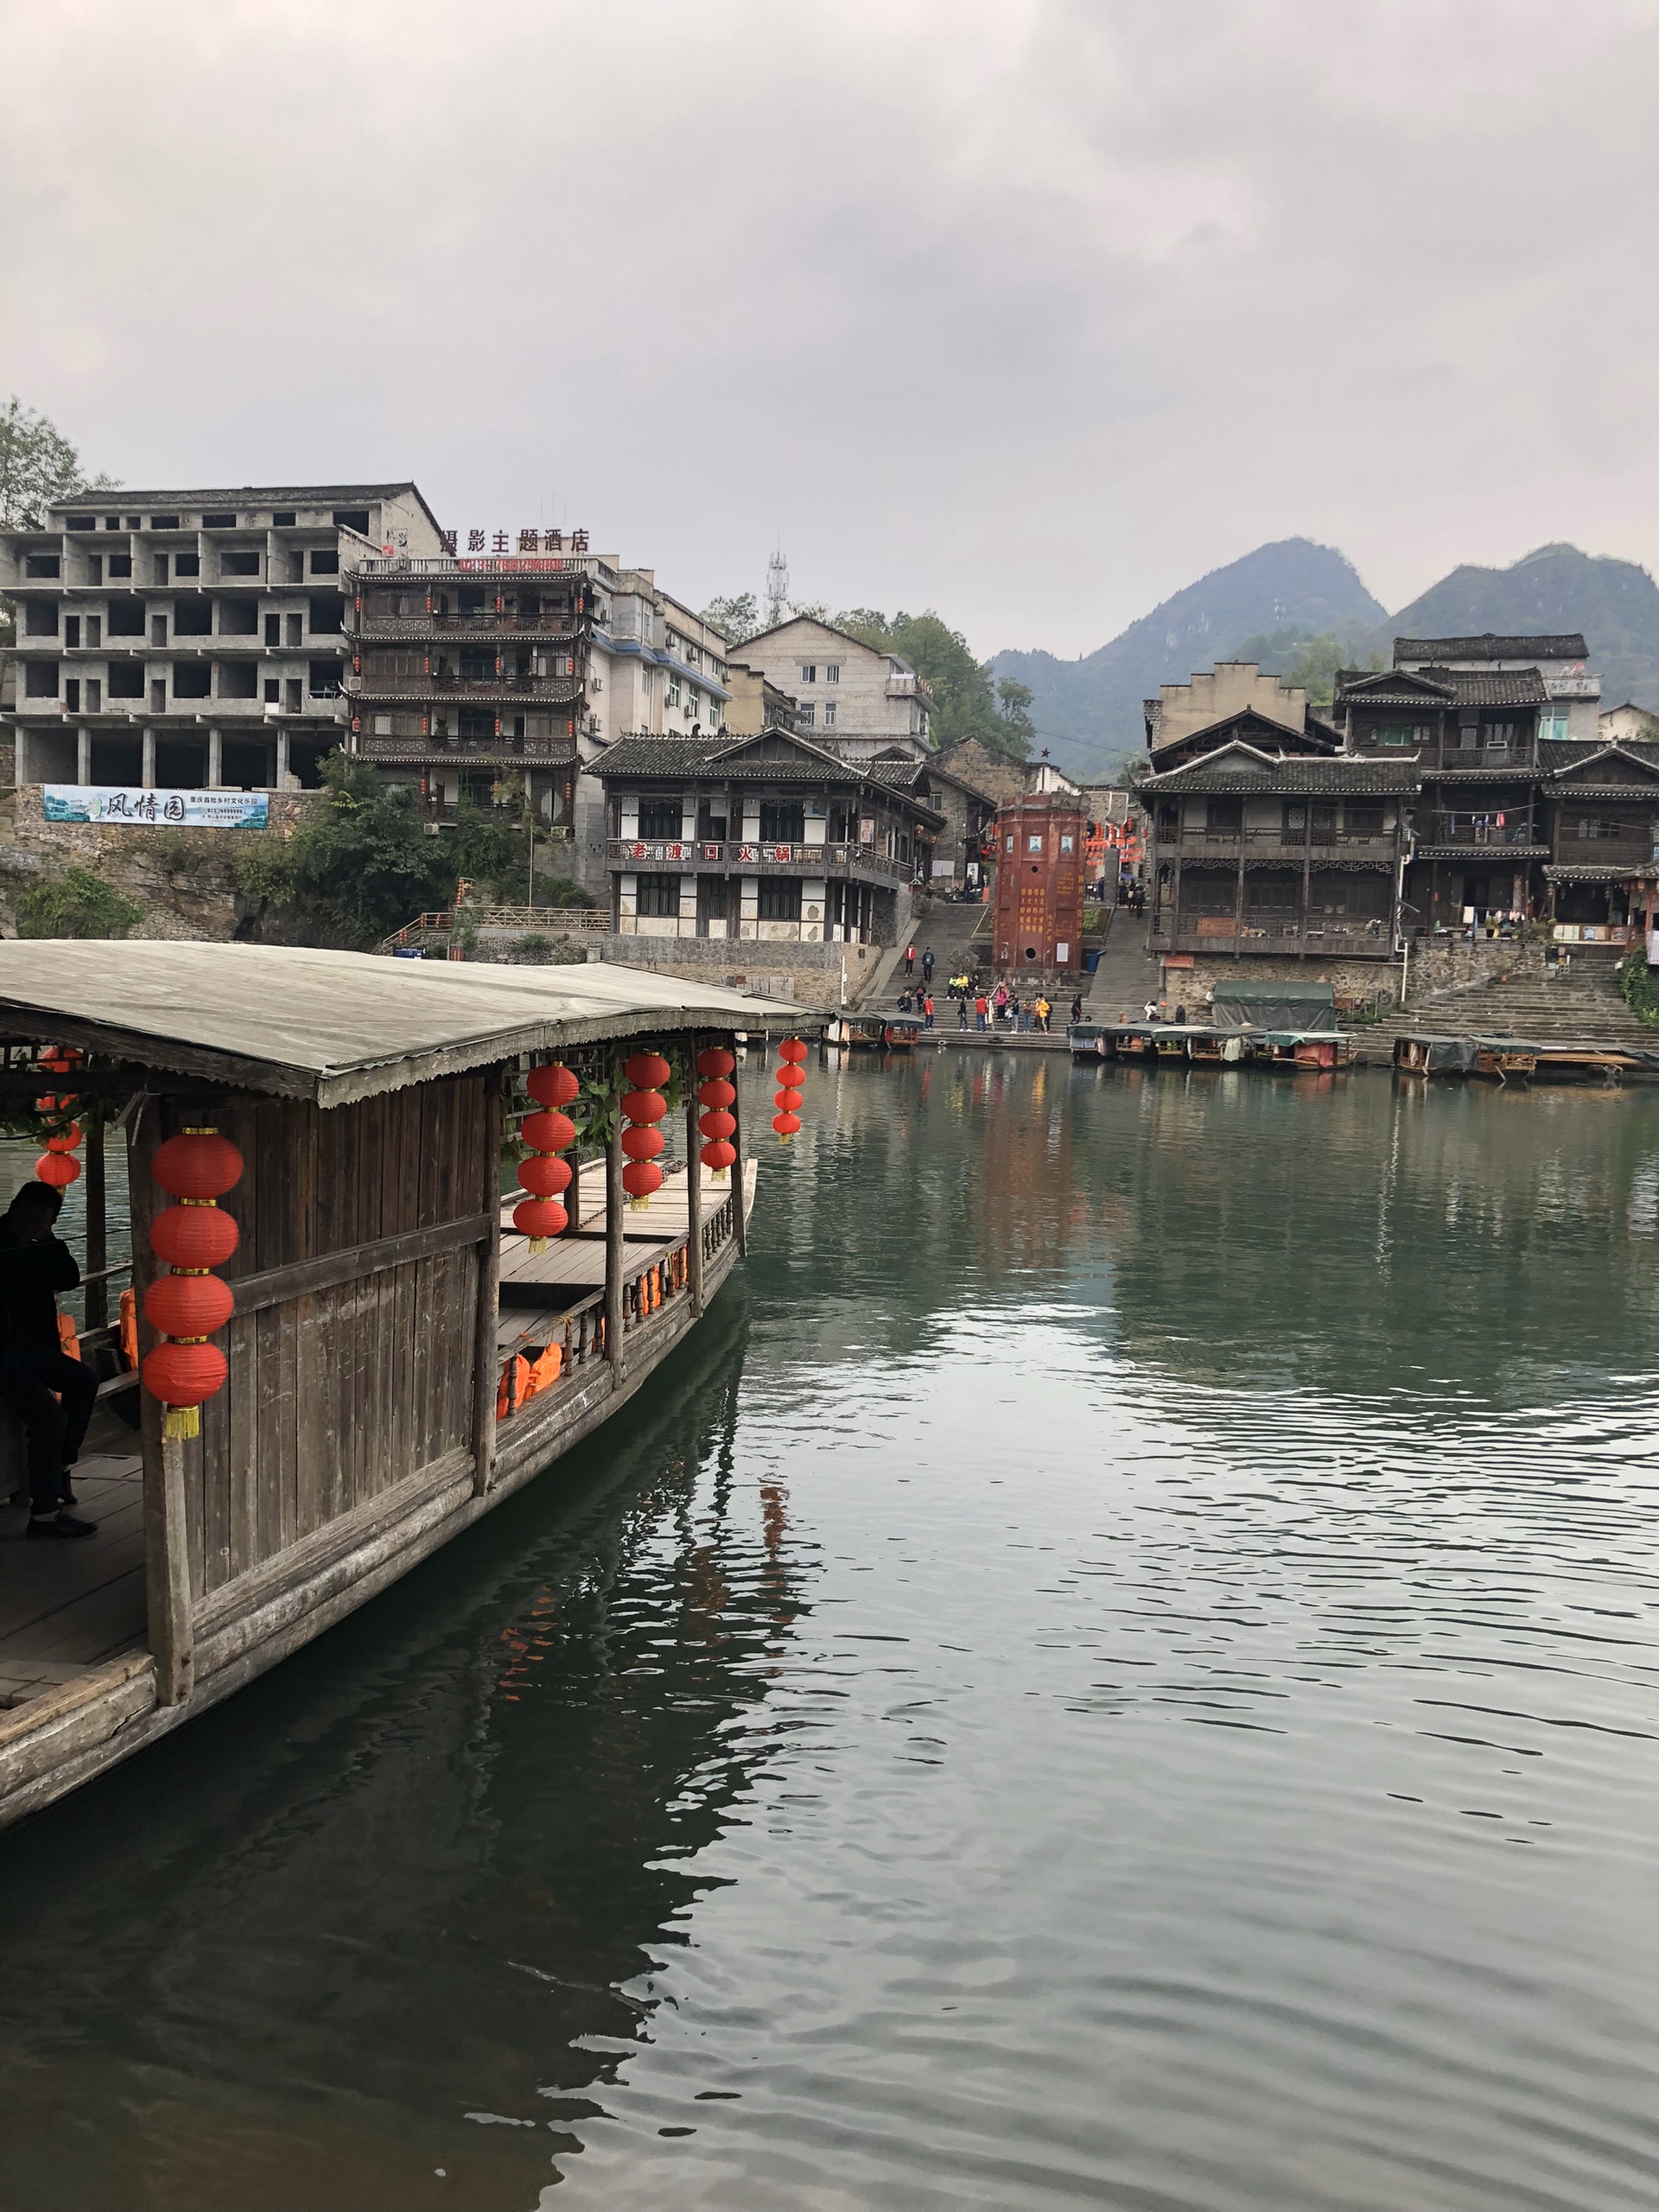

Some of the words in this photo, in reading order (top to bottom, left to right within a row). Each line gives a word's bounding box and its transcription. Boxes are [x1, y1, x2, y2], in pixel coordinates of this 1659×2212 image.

[440, 529, 589, 552] 摄影主题酒店
[190, 796, 257, 805] 重庆首批乡村文化乐园
[631, 842, 792, 862] 老渡口火锅
